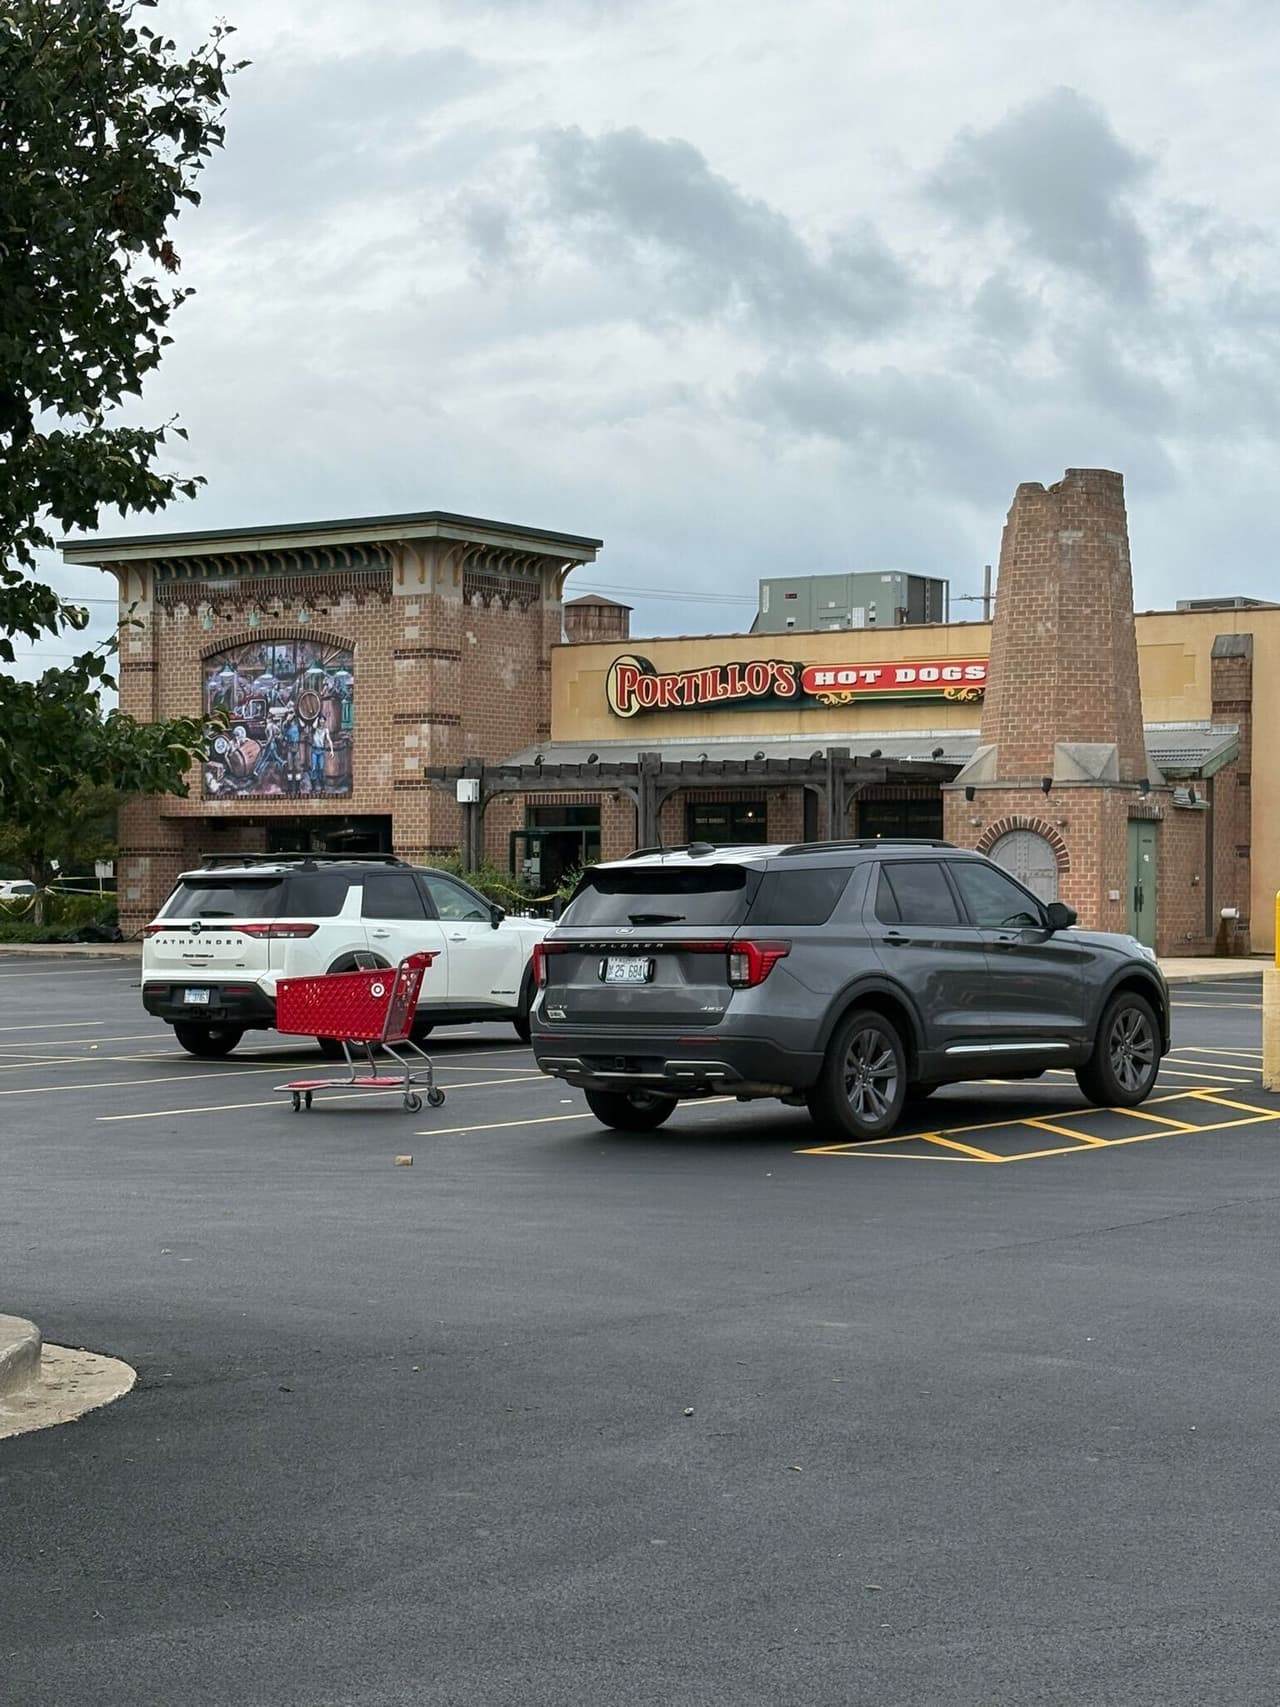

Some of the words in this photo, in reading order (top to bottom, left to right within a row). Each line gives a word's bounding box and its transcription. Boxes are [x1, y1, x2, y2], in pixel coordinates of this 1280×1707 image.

[615, 662, 797, 709] PORTILLO'S
[814, 669, 882, 687] HOT
[894, 665, 986, 683] DOGS
